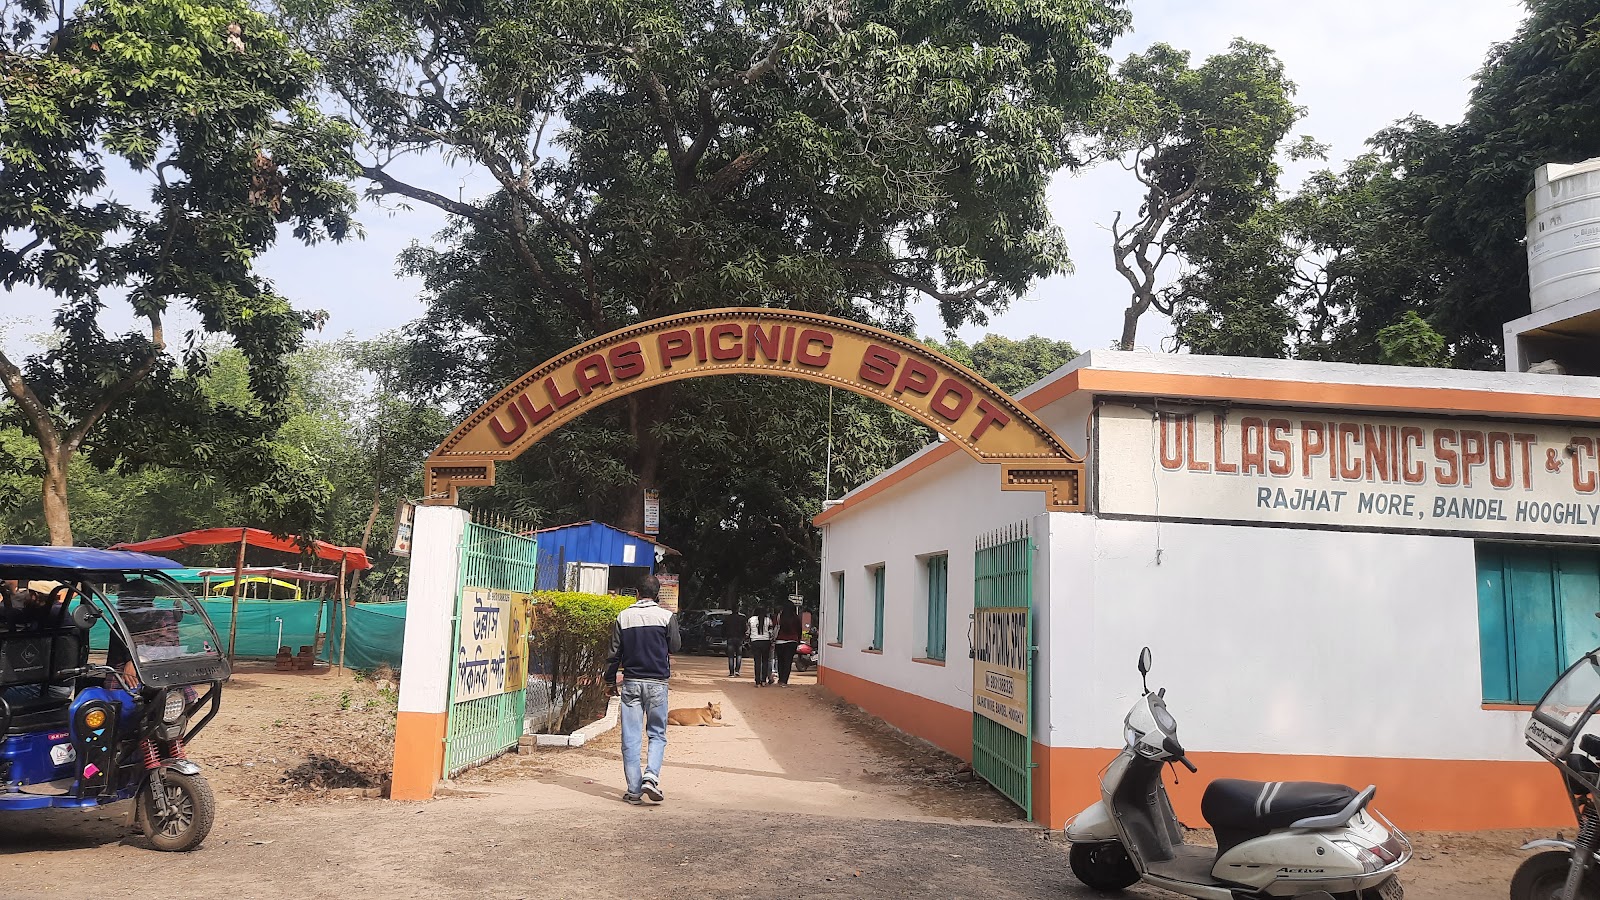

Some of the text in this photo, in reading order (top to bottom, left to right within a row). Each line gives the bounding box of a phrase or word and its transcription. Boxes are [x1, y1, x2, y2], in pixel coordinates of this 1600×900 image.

[489, 324, 1010, 447] ULLAS PICNIC SPOT
[1159, 412, 1600, 496] ULLAS PICNIC SPOT & C
[1257, 486, 1347, 513] RAJHAT
[1432, 494, 1507, 522] BANDEL
[1516, 499, 1600, 526] HOOGHLY
[472, 592, 500, 640] উল্লাস
[992, 613, 1010, 667] PICNIC
[1010, 613, 1026, 671] SPOT
[456, 644, 490, 697] পিকনিক
